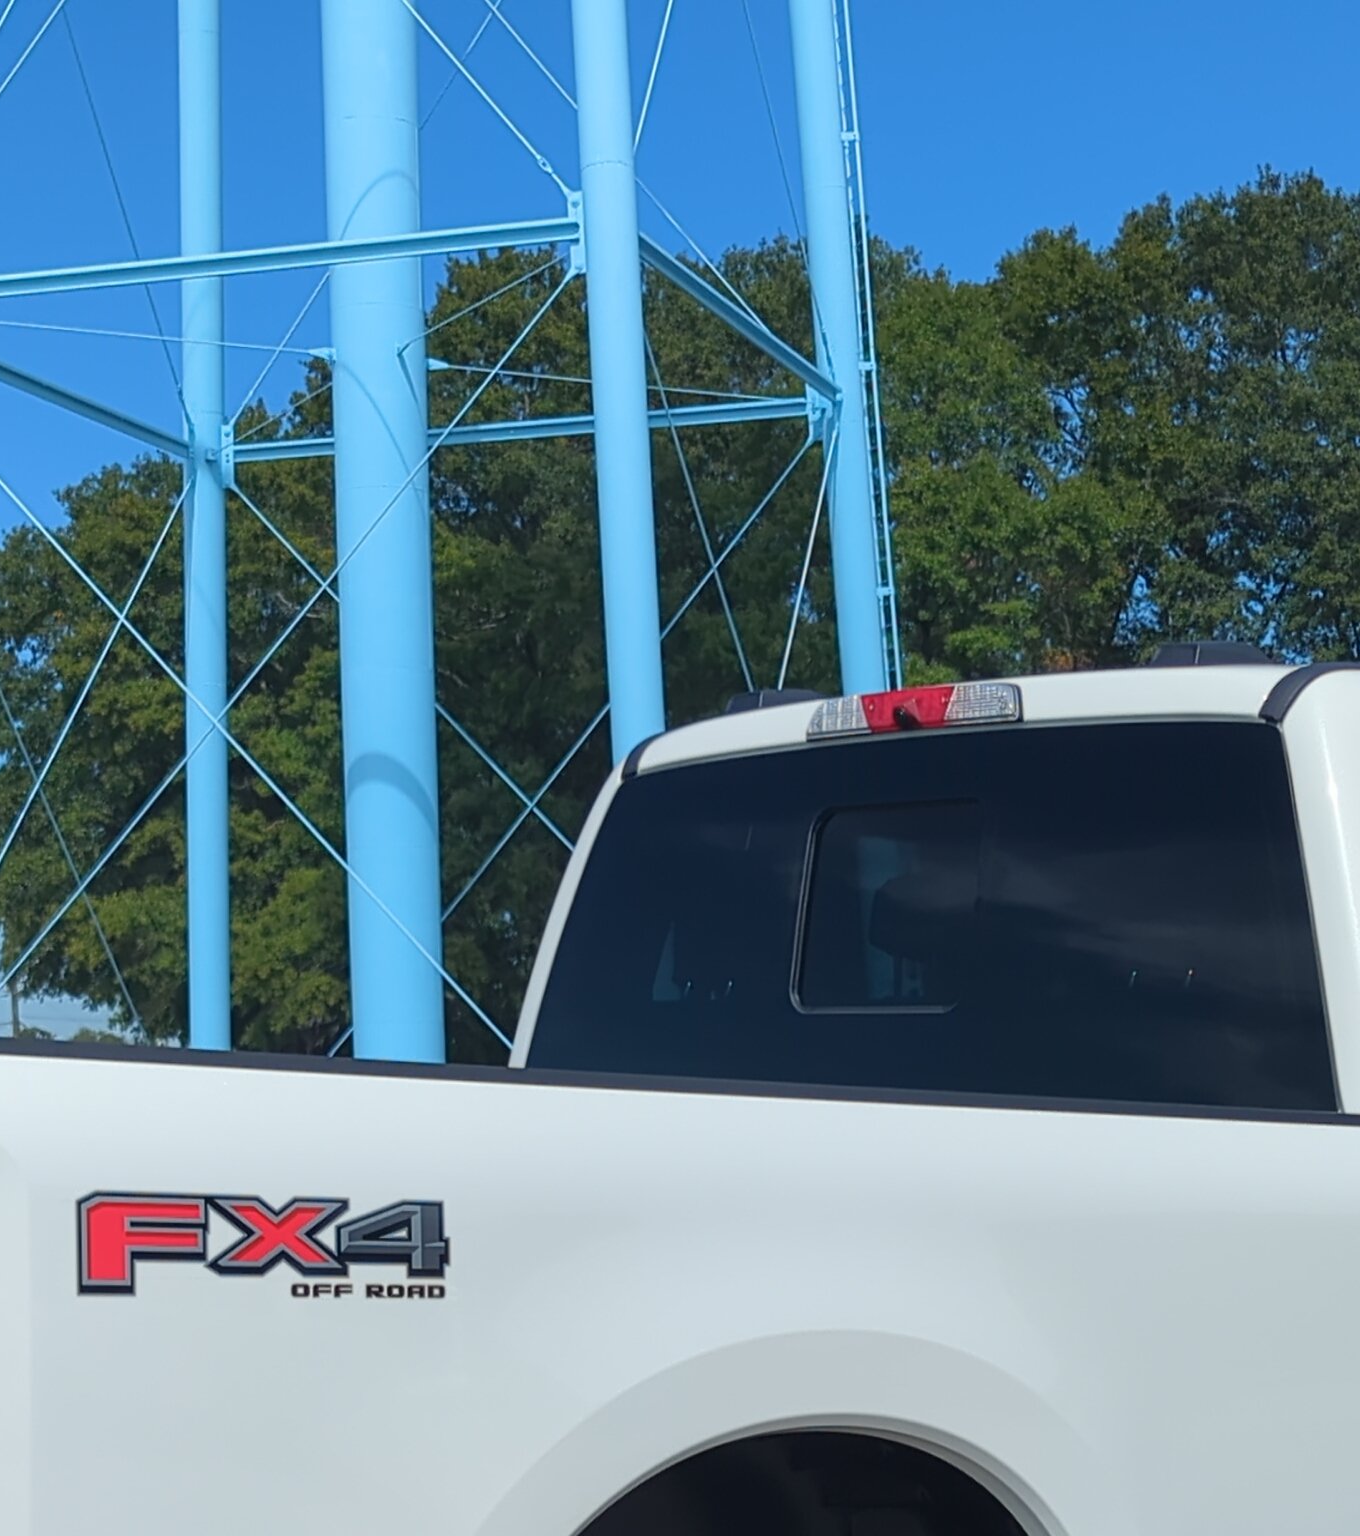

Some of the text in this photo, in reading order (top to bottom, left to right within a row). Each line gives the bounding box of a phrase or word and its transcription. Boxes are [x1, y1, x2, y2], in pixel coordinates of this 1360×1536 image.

[76, 1190, 451, 1297] FX4
[291, 1283, 446, 1299] OFF ROAD
